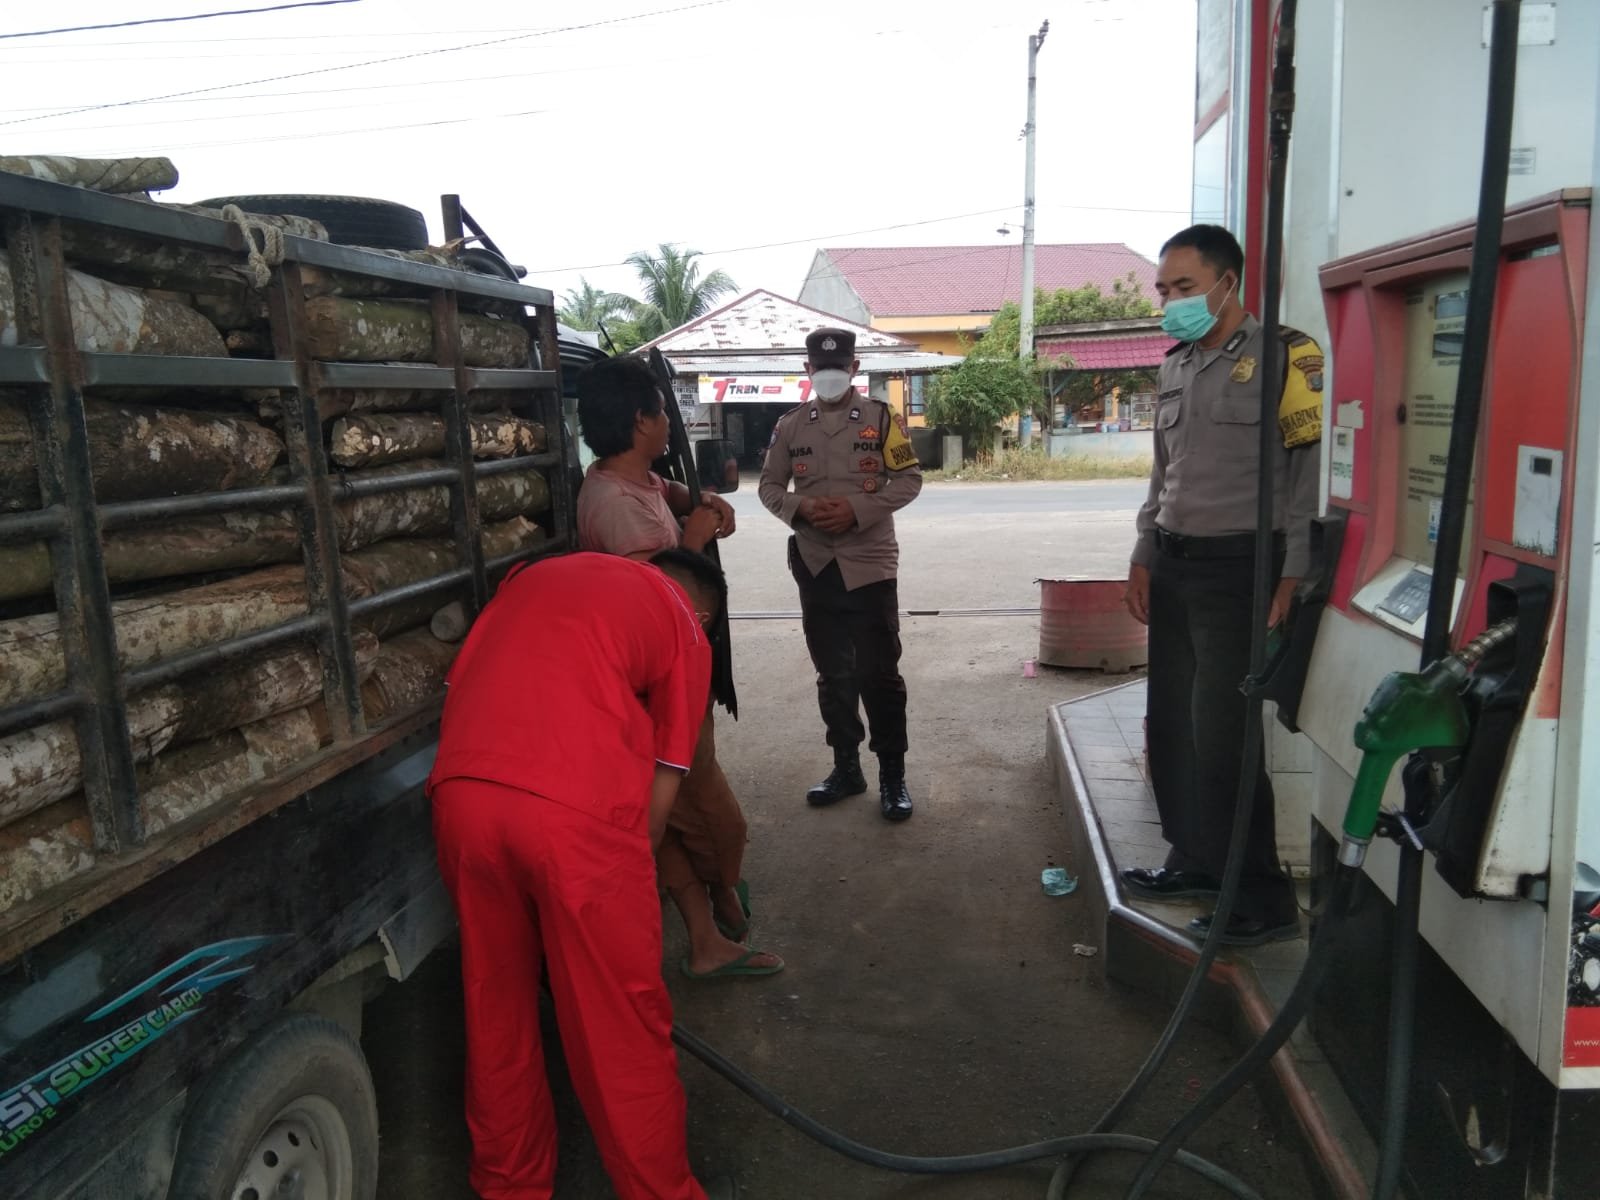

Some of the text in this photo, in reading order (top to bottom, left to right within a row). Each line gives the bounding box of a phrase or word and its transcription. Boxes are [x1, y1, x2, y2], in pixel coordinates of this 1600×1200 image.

[50, 1022, 149, 1095] SUPER
[146, 987, 203, 1029] CARGO
[0, 1115, 44, 1158] URO
